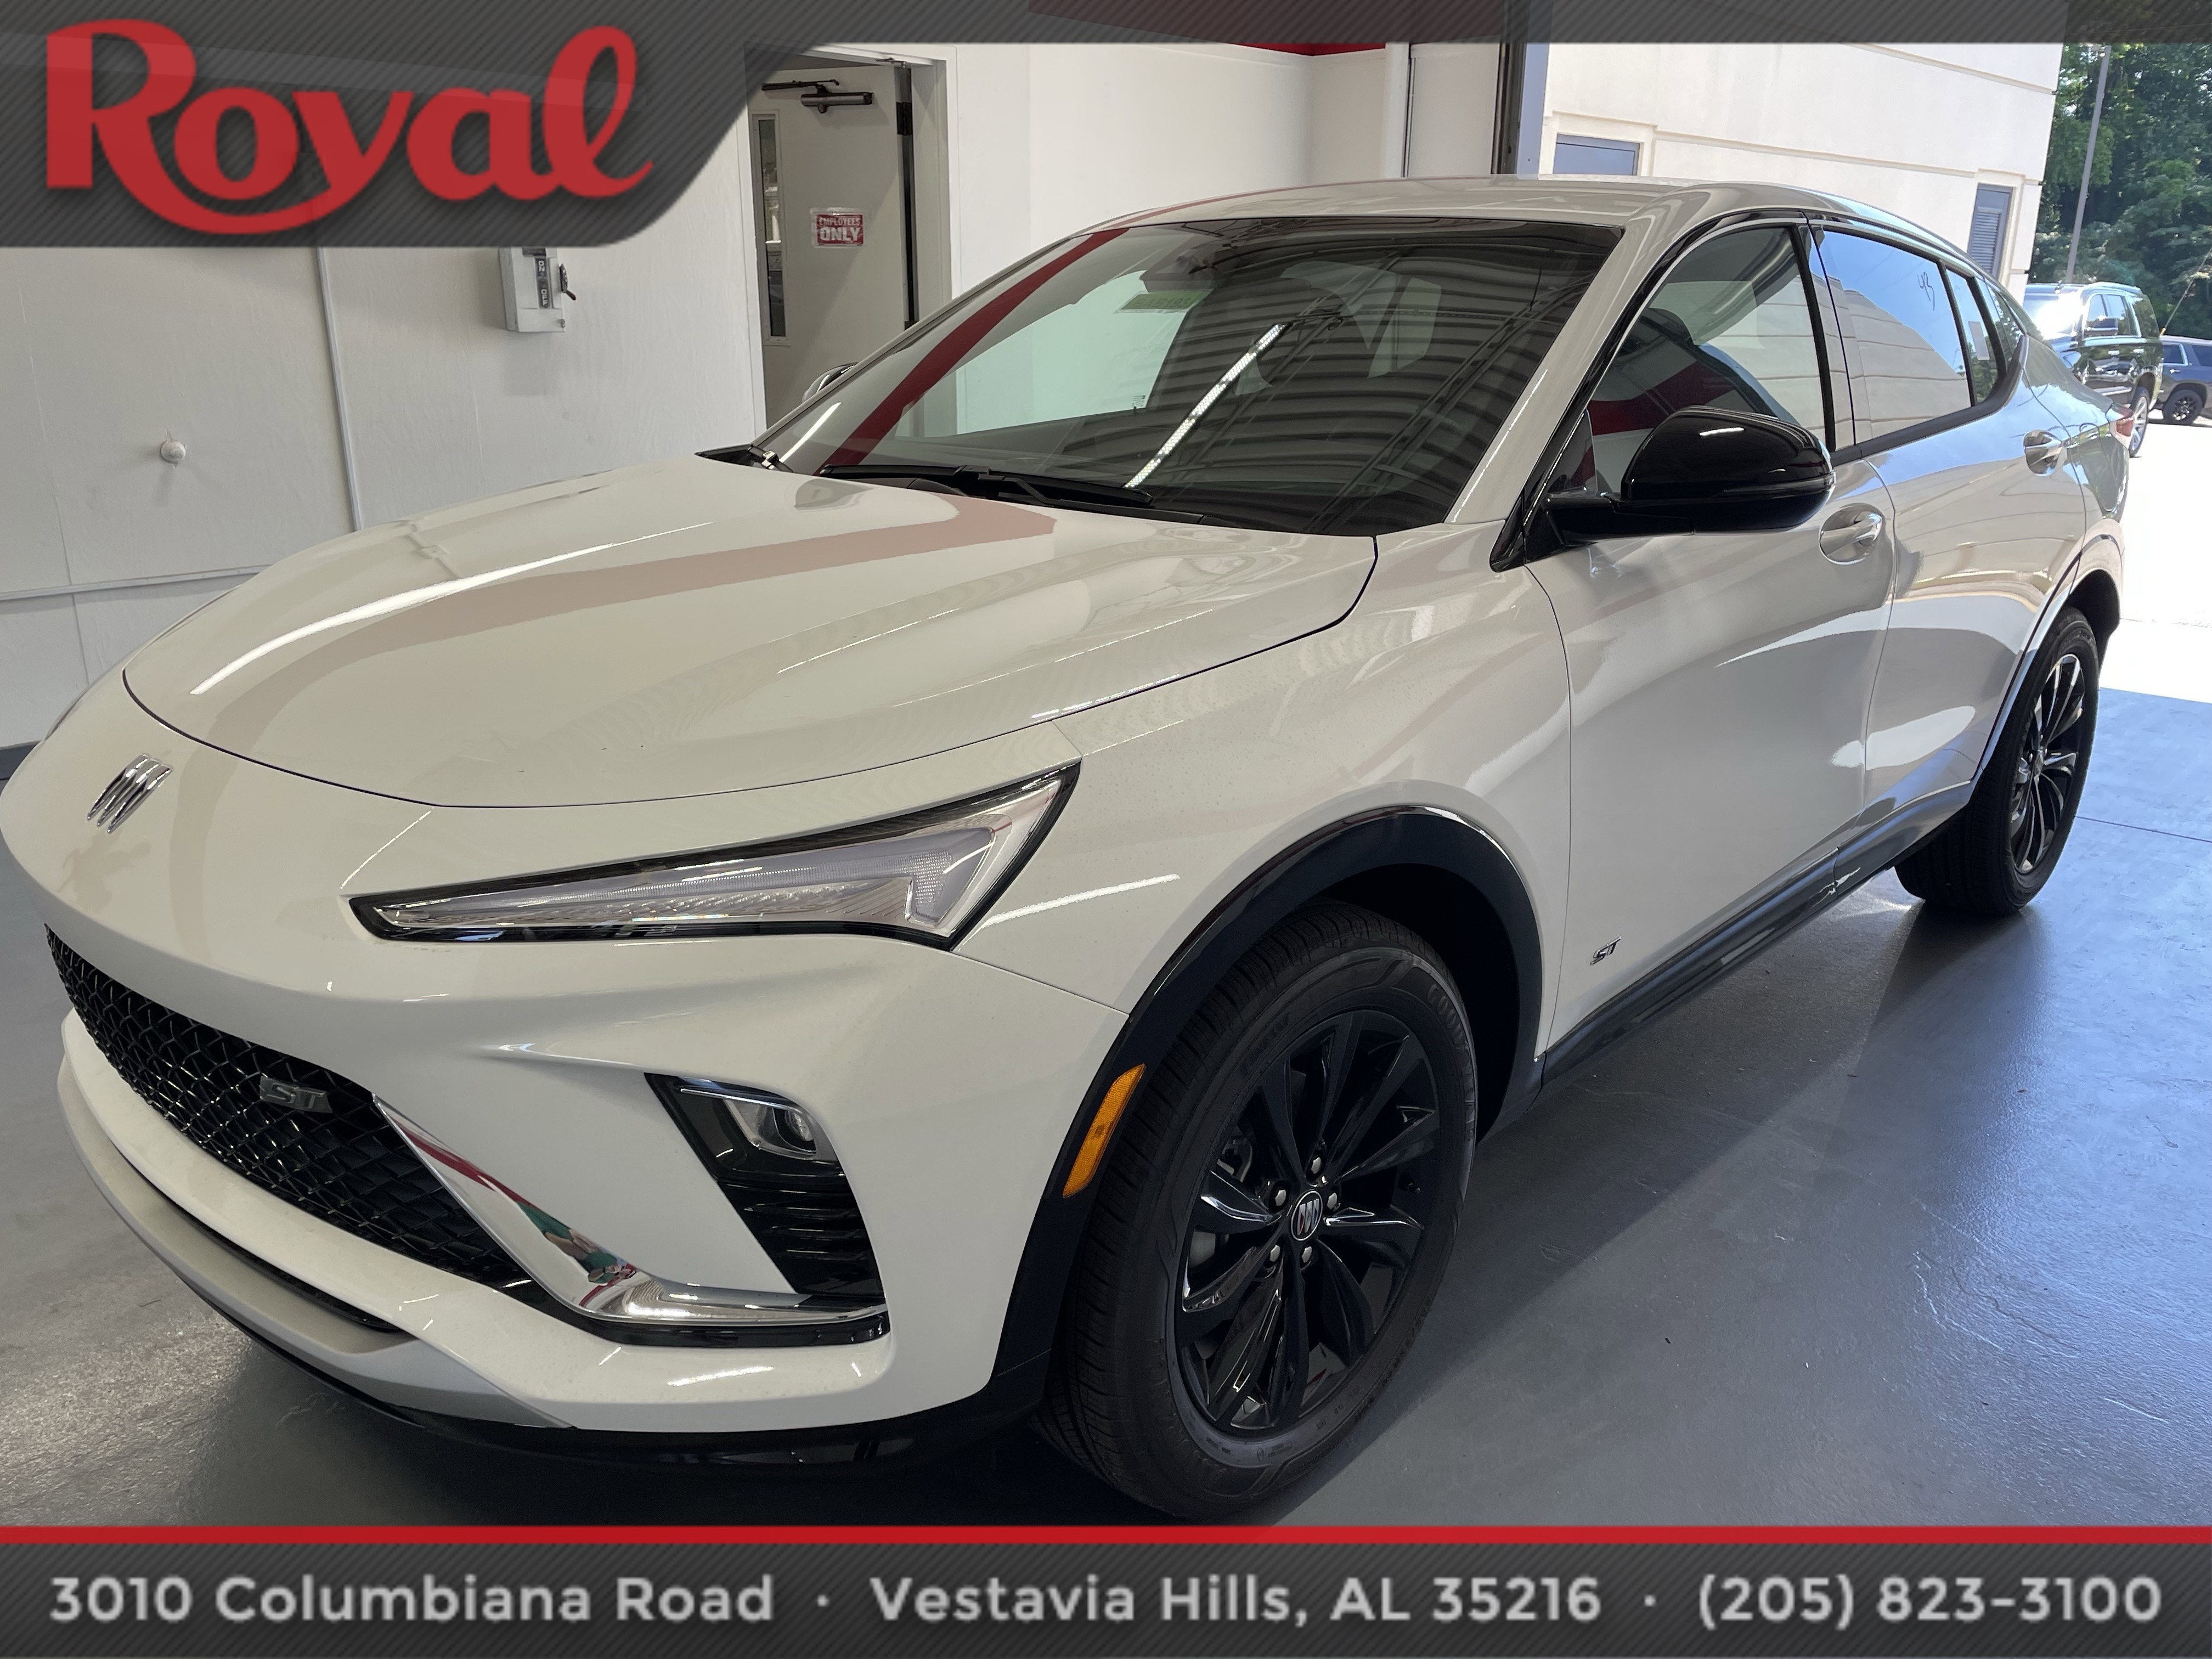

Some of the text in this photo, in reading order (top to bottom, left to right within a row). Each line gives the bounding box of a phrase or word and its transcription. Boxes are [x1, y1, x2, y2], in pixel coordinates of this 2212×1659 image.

[819, 217, 861, 226] EMPLOYEES
[820, 227, 861, 241] ONLY
[538, 261, 545, 272] ON
[1589, 936, 1621, 966] ST
[266, 1082, 328, 1109] ST
